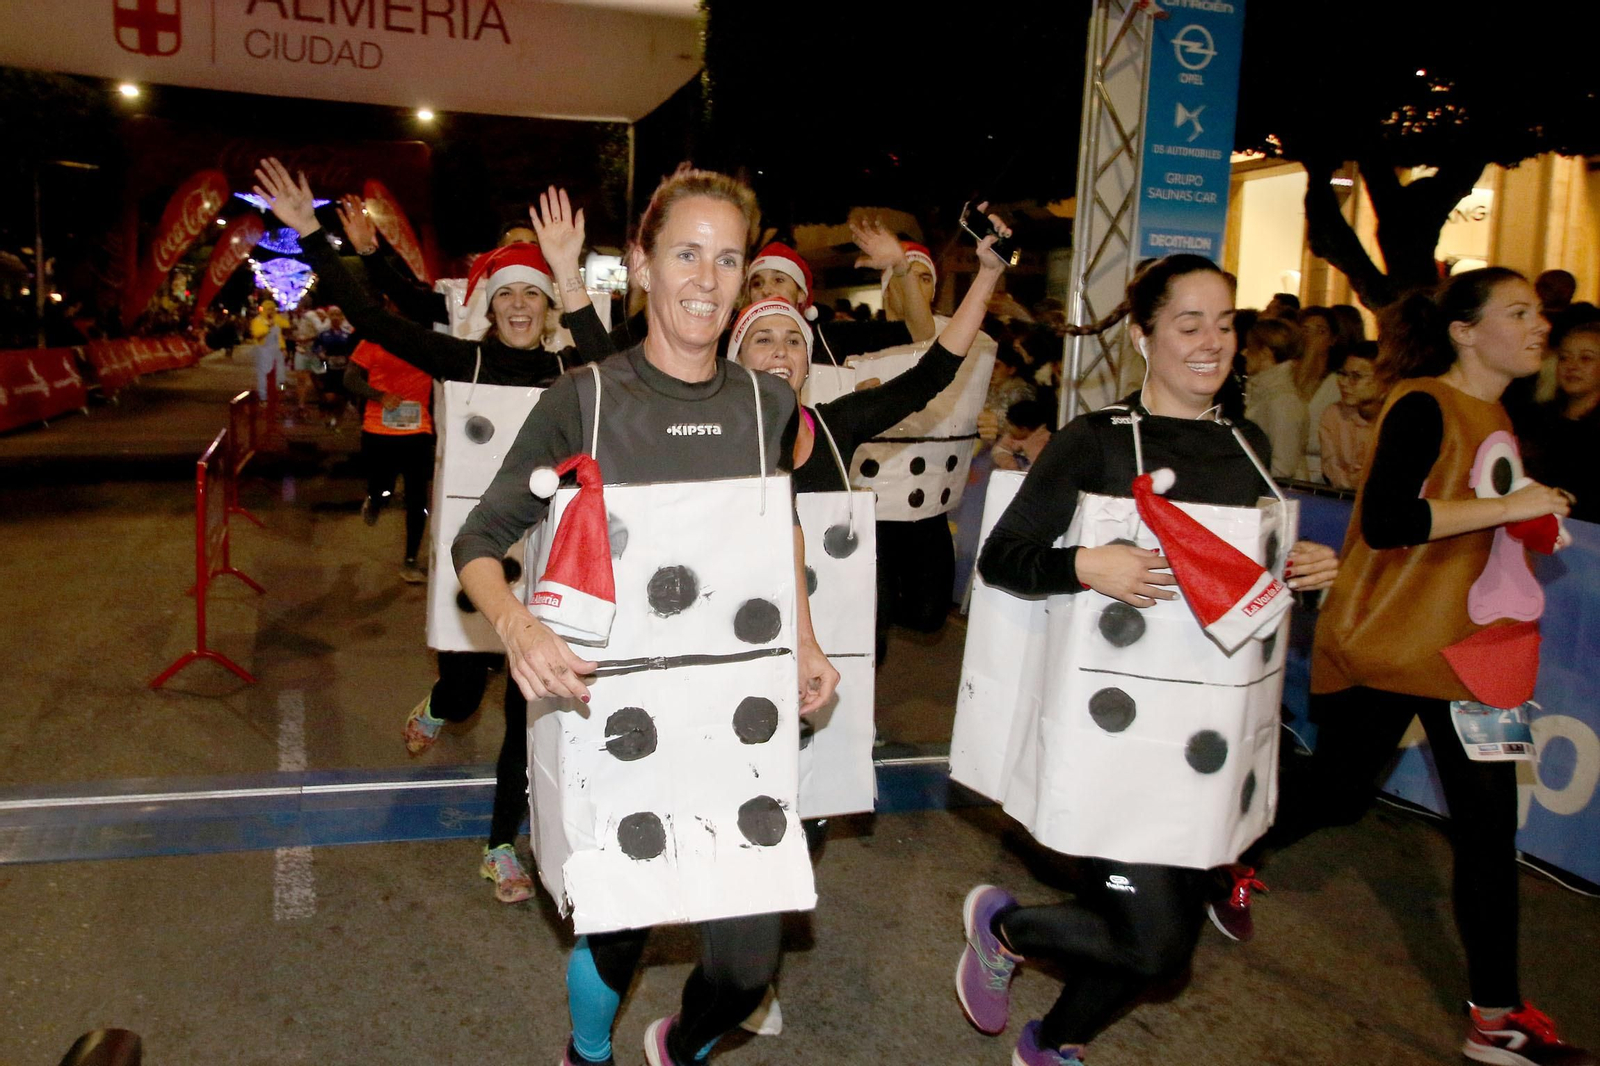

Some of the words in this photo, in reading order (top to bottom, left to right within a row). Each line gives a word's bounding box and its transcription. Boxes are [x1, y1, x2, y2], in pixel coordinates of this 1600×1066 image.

[244, 28, 384, 70] CIUDAD
[1180, 73, 1204, 85] OPEL
[1153, 144, 1165, 154] DS
[1167, 145, 1222, 160] AUTOMOBILES
[1164, 171, 1204, 187] GRUPO
[1147, 187, 1194, 202] SALINAS
[1195, 191, 1218, 204] CAR
[1149, 233, 1213, 250] DECATHLON
[1243, 604, 1260, 616] La
[1255, 592, 1272, 607] Voz
